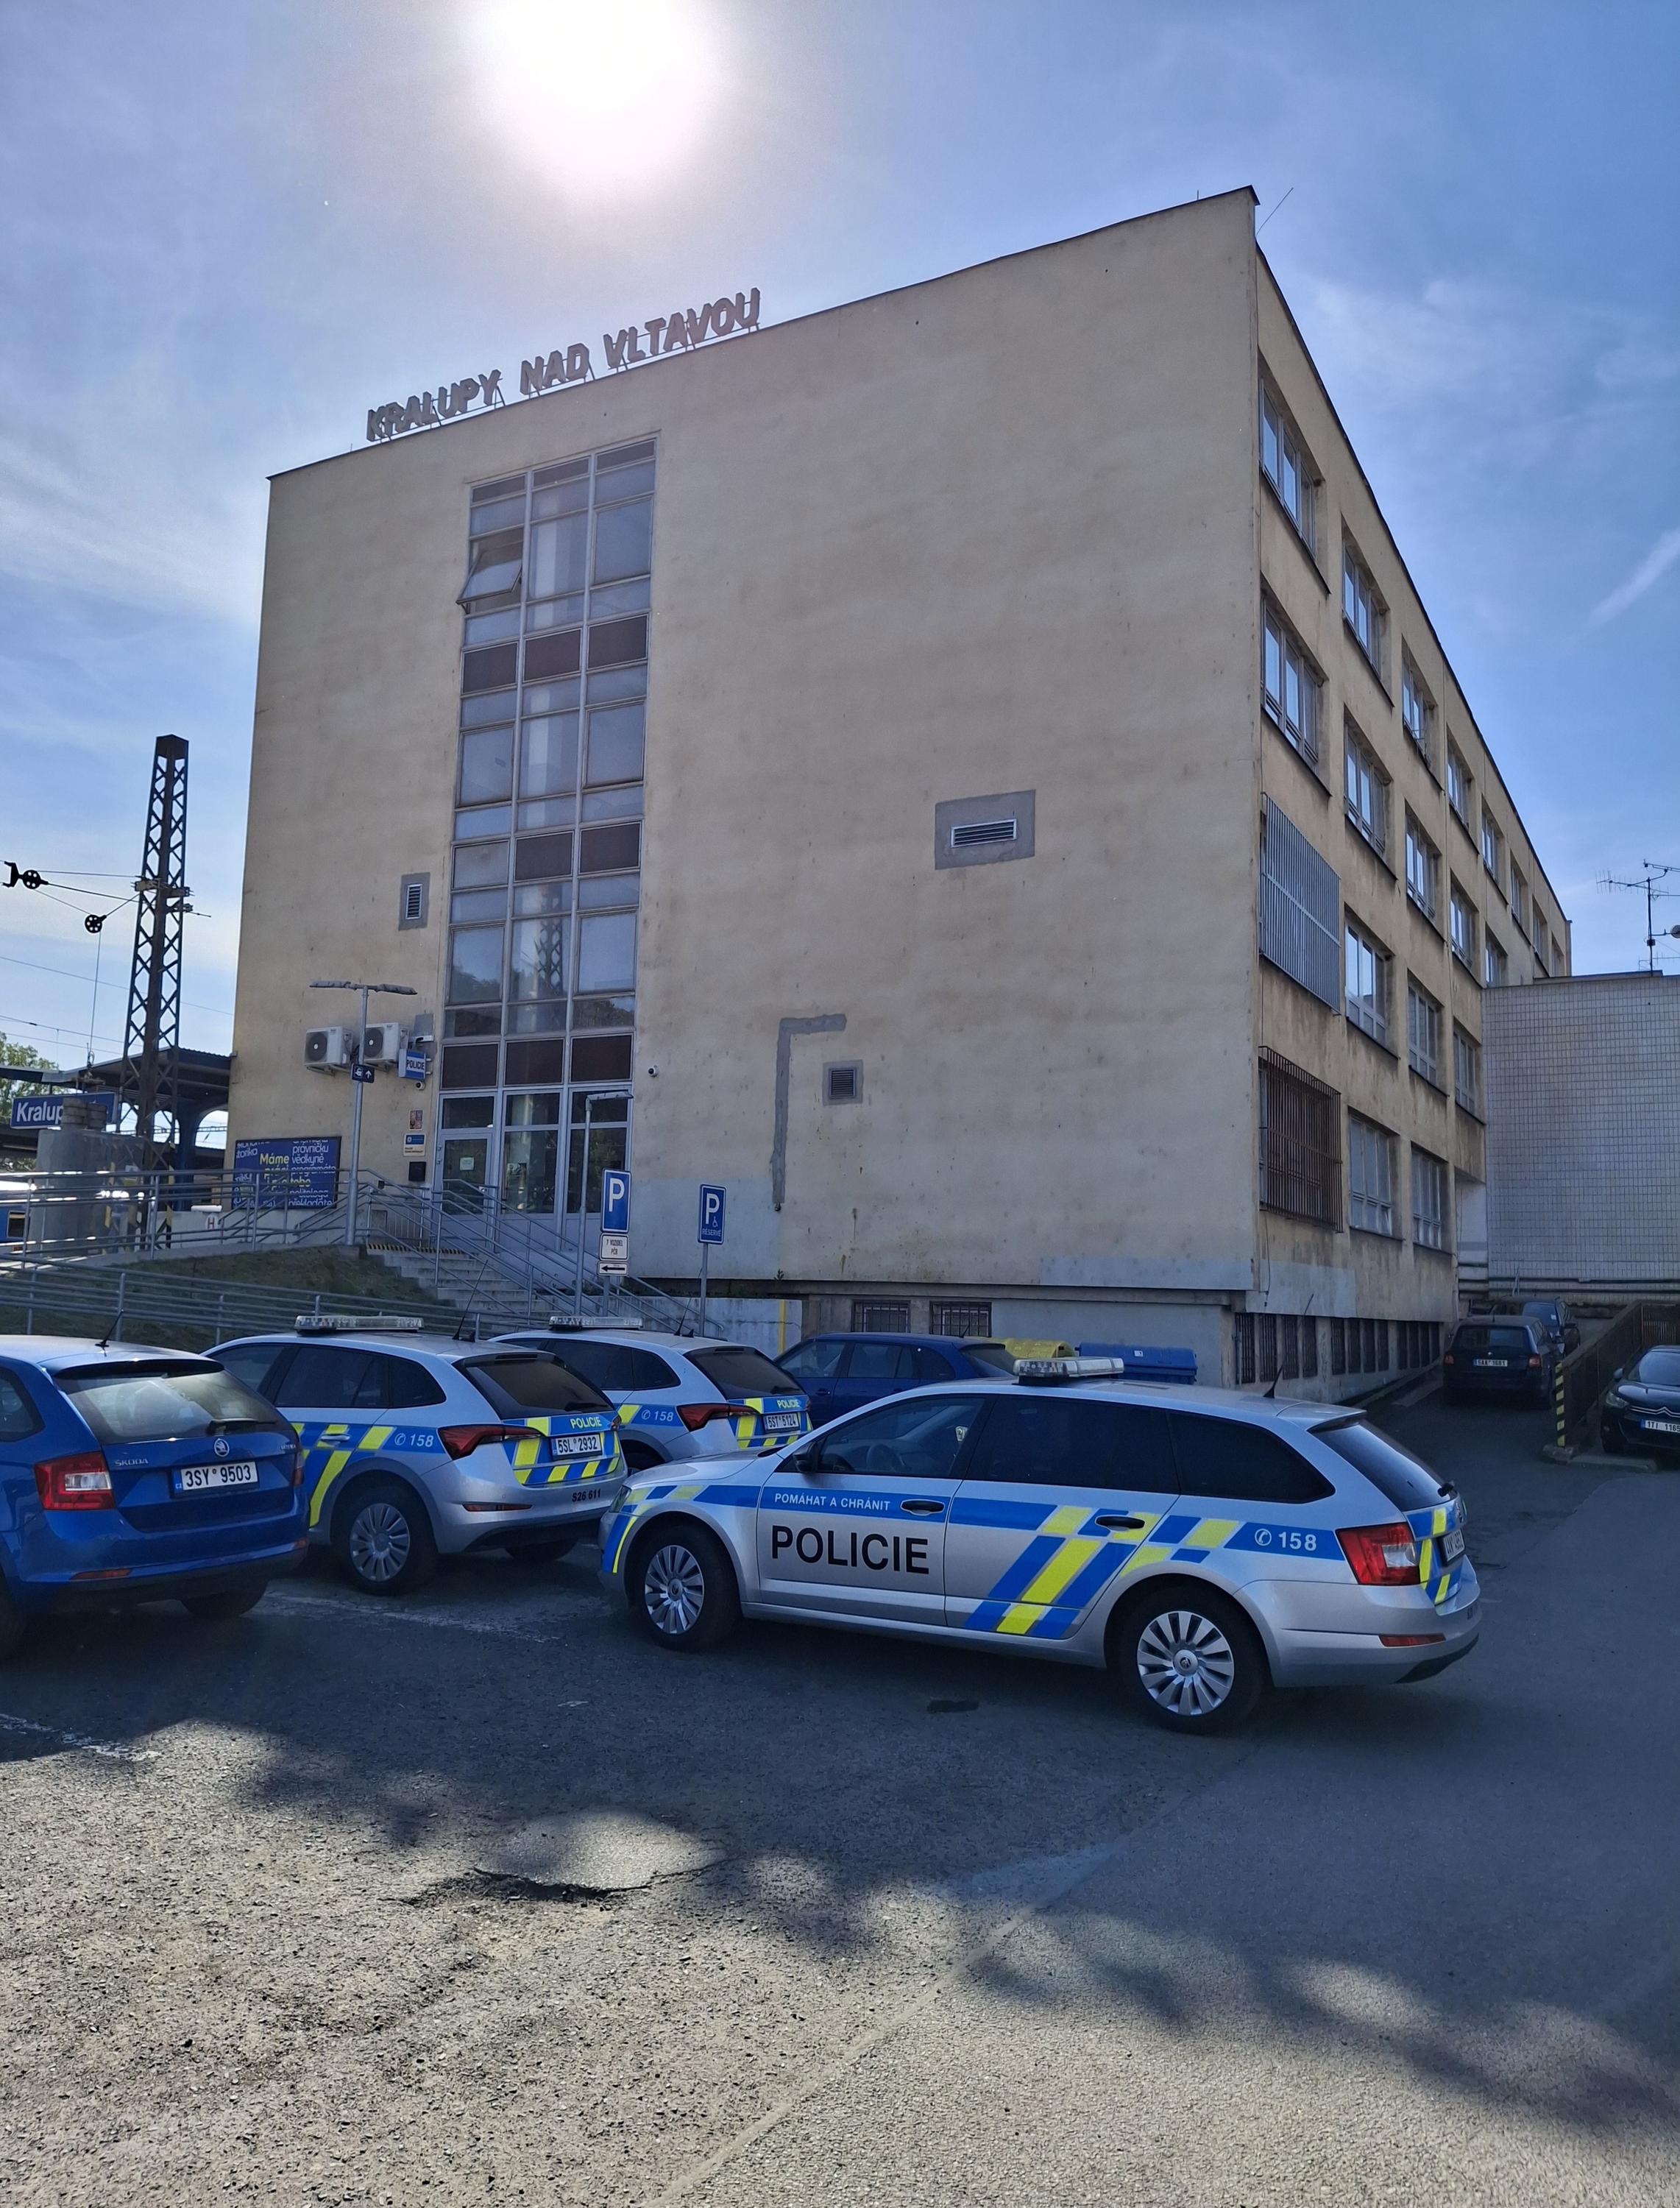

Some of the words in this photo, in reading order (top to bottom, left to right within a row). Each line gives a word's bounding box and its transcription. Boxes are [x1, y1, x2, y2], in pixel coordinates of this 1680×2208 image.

[366, 369, 501, 442] KRALUPY
[519, 342, 590, 396] NAD
[603, 287, 761, 369] VLTAVOU
[406, 1059, 425, 1070] POLICIE
[260, 1153, 289, 1165] Máme
[609, 1178, 625, 1212] P
[705, 1193, 720, 1225] P
[776, 1398, 801, 1410] POLICIE
[570, 1416, 603, 1429] POLICIE
[653, 1411, 673, 1422] 158
[410, 1434, 434, 1448] 158
[557, 1439, 573, 1454] 5SL
[578, 1436, 598, 1451] 2932
[184, 1468, 210, 1487] 3SY
[220, 1465, 252, 1484] 9503
[775, 1493, 827, 1507] POMÁHAT
[830, 1498, 837, 1507] A
[840, 1497, 890, 1511] CHRÁNIT
[772, 1525, 929, 1574] POLICIE
[1278, 1532, 1317, 1551] 158
